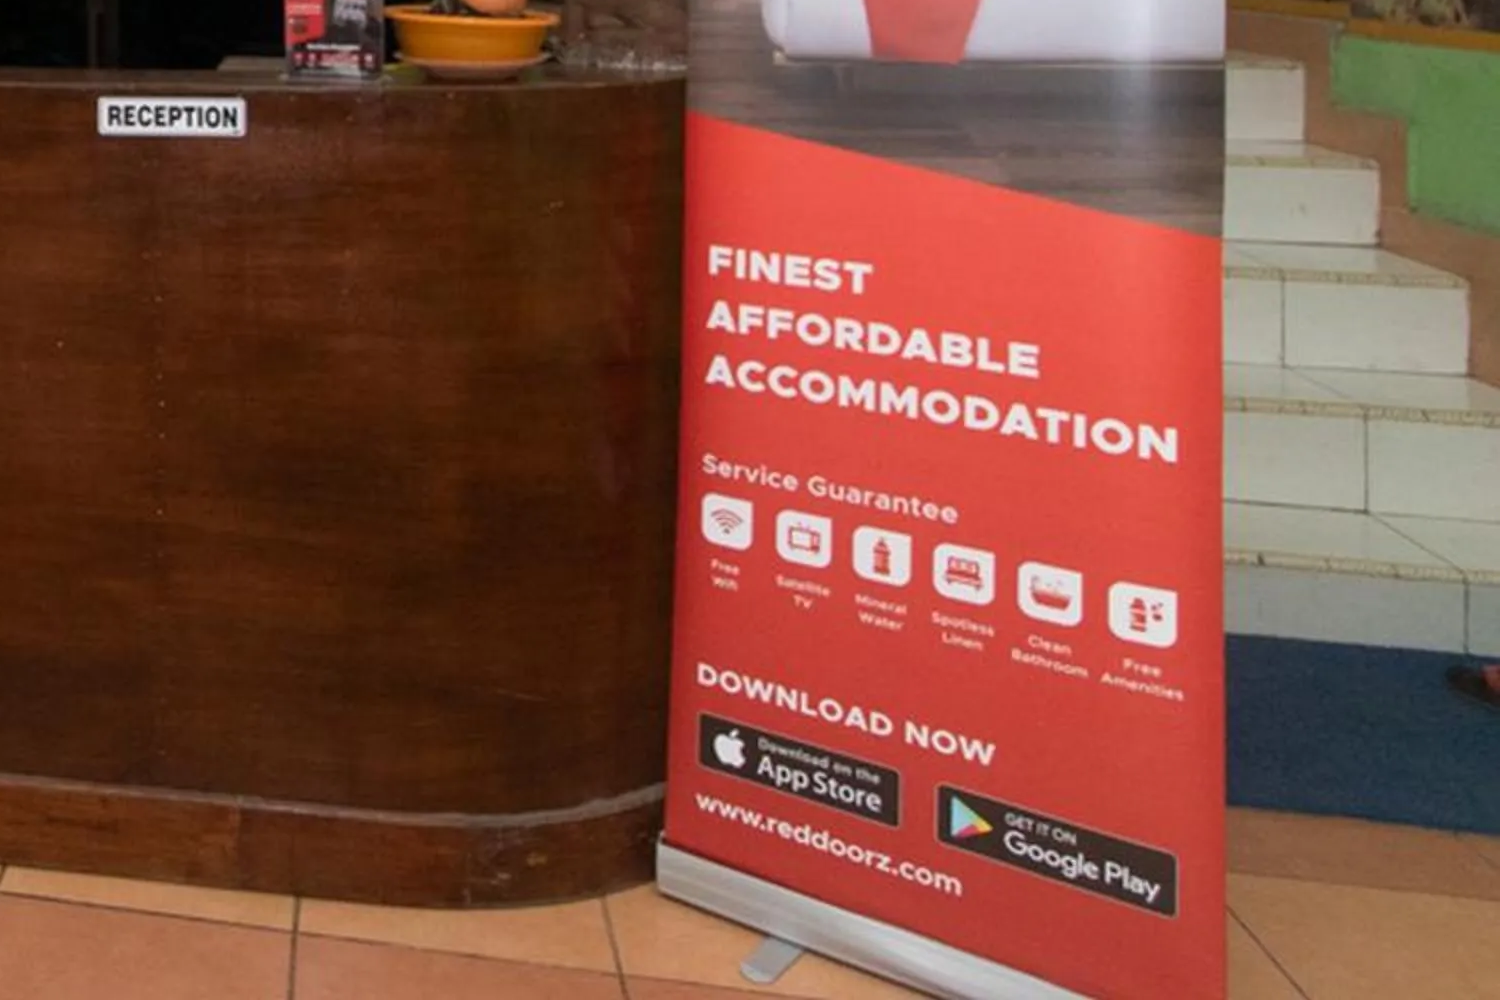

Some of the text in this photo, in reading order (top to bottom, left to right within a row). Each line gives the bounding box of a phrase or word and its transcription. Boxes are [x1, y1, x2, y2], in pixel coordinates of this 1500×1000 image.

[108, 105, 237, 128] RECEPTION
[708, 245, 873, 294] FINEST
[706, 300, 1040, 378] AFFORDABLE
[705, 356, 1178, 462] ACCOMMODATION
[702, 453, 958, 524] Service Guarantee
[710, 558, 740, 576] Free
[776, 574, 831, 597] Satellite
[793, 594, 813, 609] TV
[855, 593, 907, 615] Mineral
[858, 611, 904, 631] Water
[931, 611, 995, 638] Spotless
[941, 631, 984, 651] Linen
[1027, 634, 1072, 656] Clean
[1011, 648, 1089, 678] Bathroom
[1122, 658, 1162, 677] Free
[1101, 672, 1184, 702] Amenities
[697, 662, 997, 767] DOWNLOAD NOW
[757, 737, 880, 785] Download on the
[757, 755, 883, 813] App Store
[1004, 812, 1077, 846] GET IT ON
[696, 792, 963, 897] www.reddoorz.com
[1003, 830, 1161, 903] Google Play
